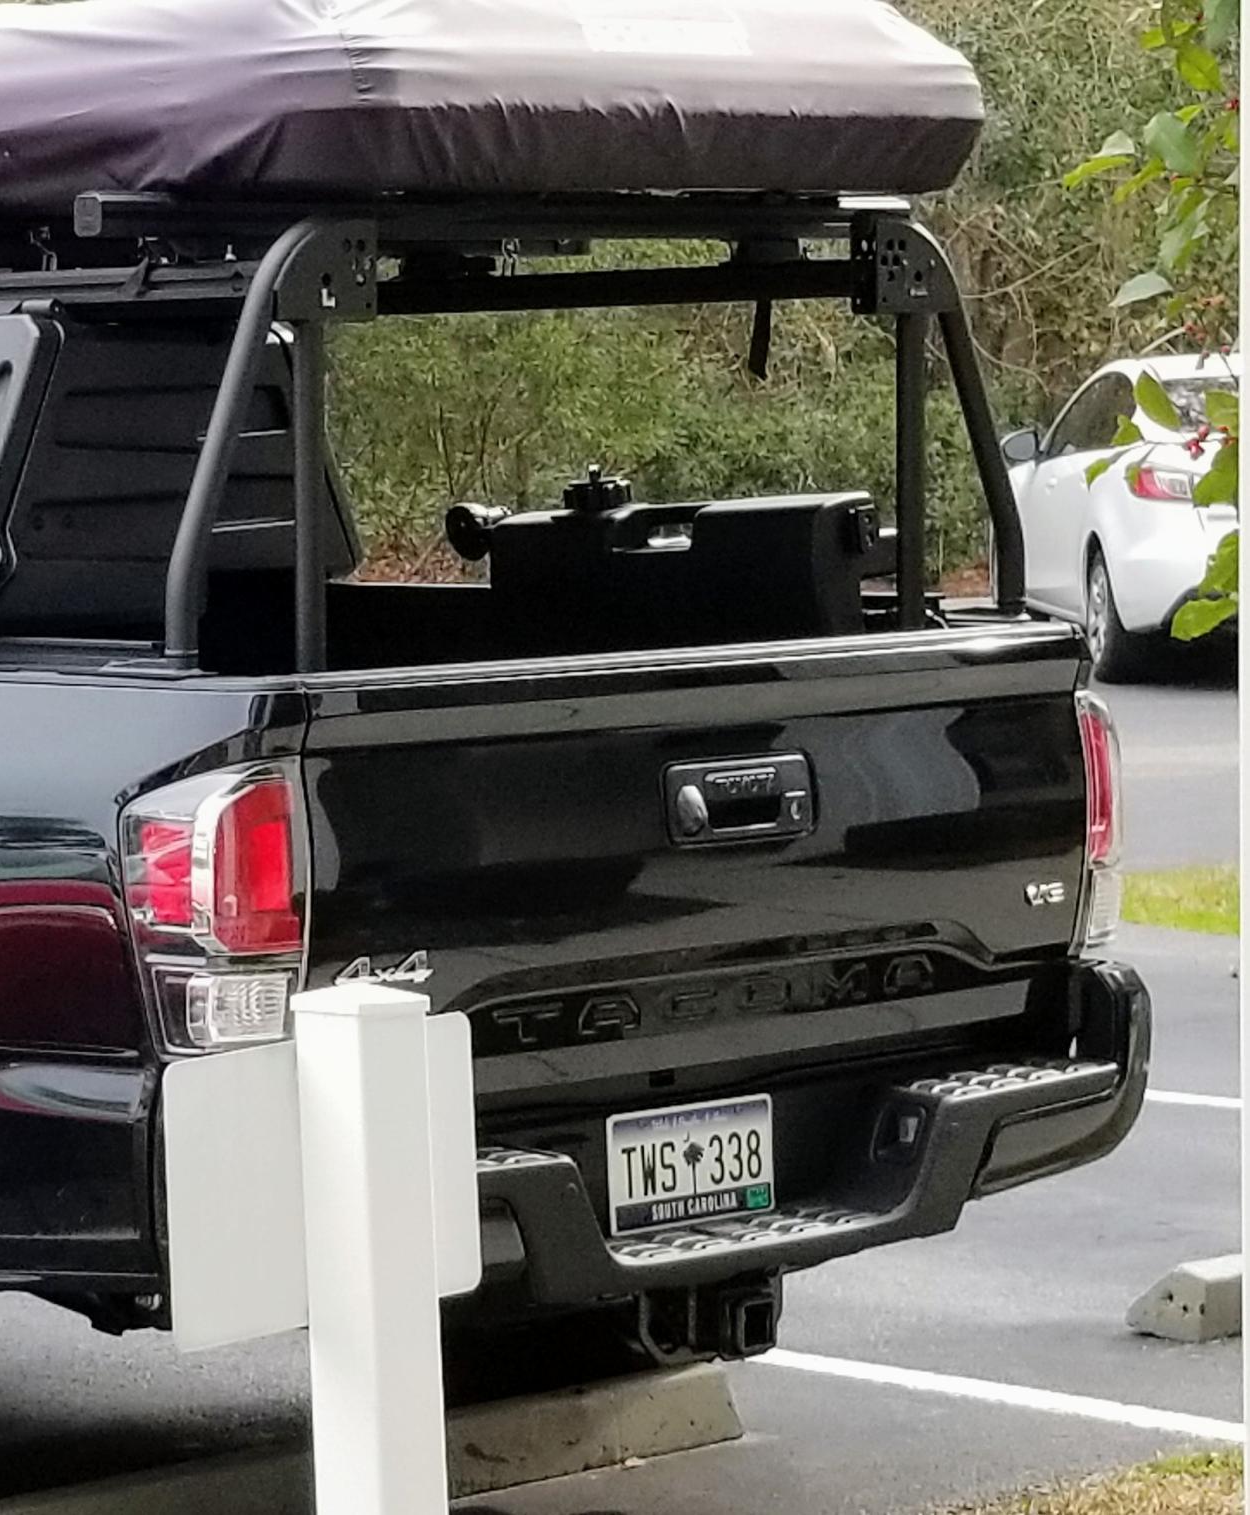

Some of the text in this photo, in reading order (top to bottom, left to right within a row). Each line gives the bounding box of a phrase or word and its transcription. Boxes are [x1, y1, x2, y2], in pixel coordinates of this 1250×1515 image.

[333, 949, 443, 984] 4x4
[492, 953, 934, 1043] TACOMA
[621, 1129, 762, 1199] TWS 338
[652, 1201, 685, 1221] SOUTH
[687, 1191, 738, 1216] CAROLINA
